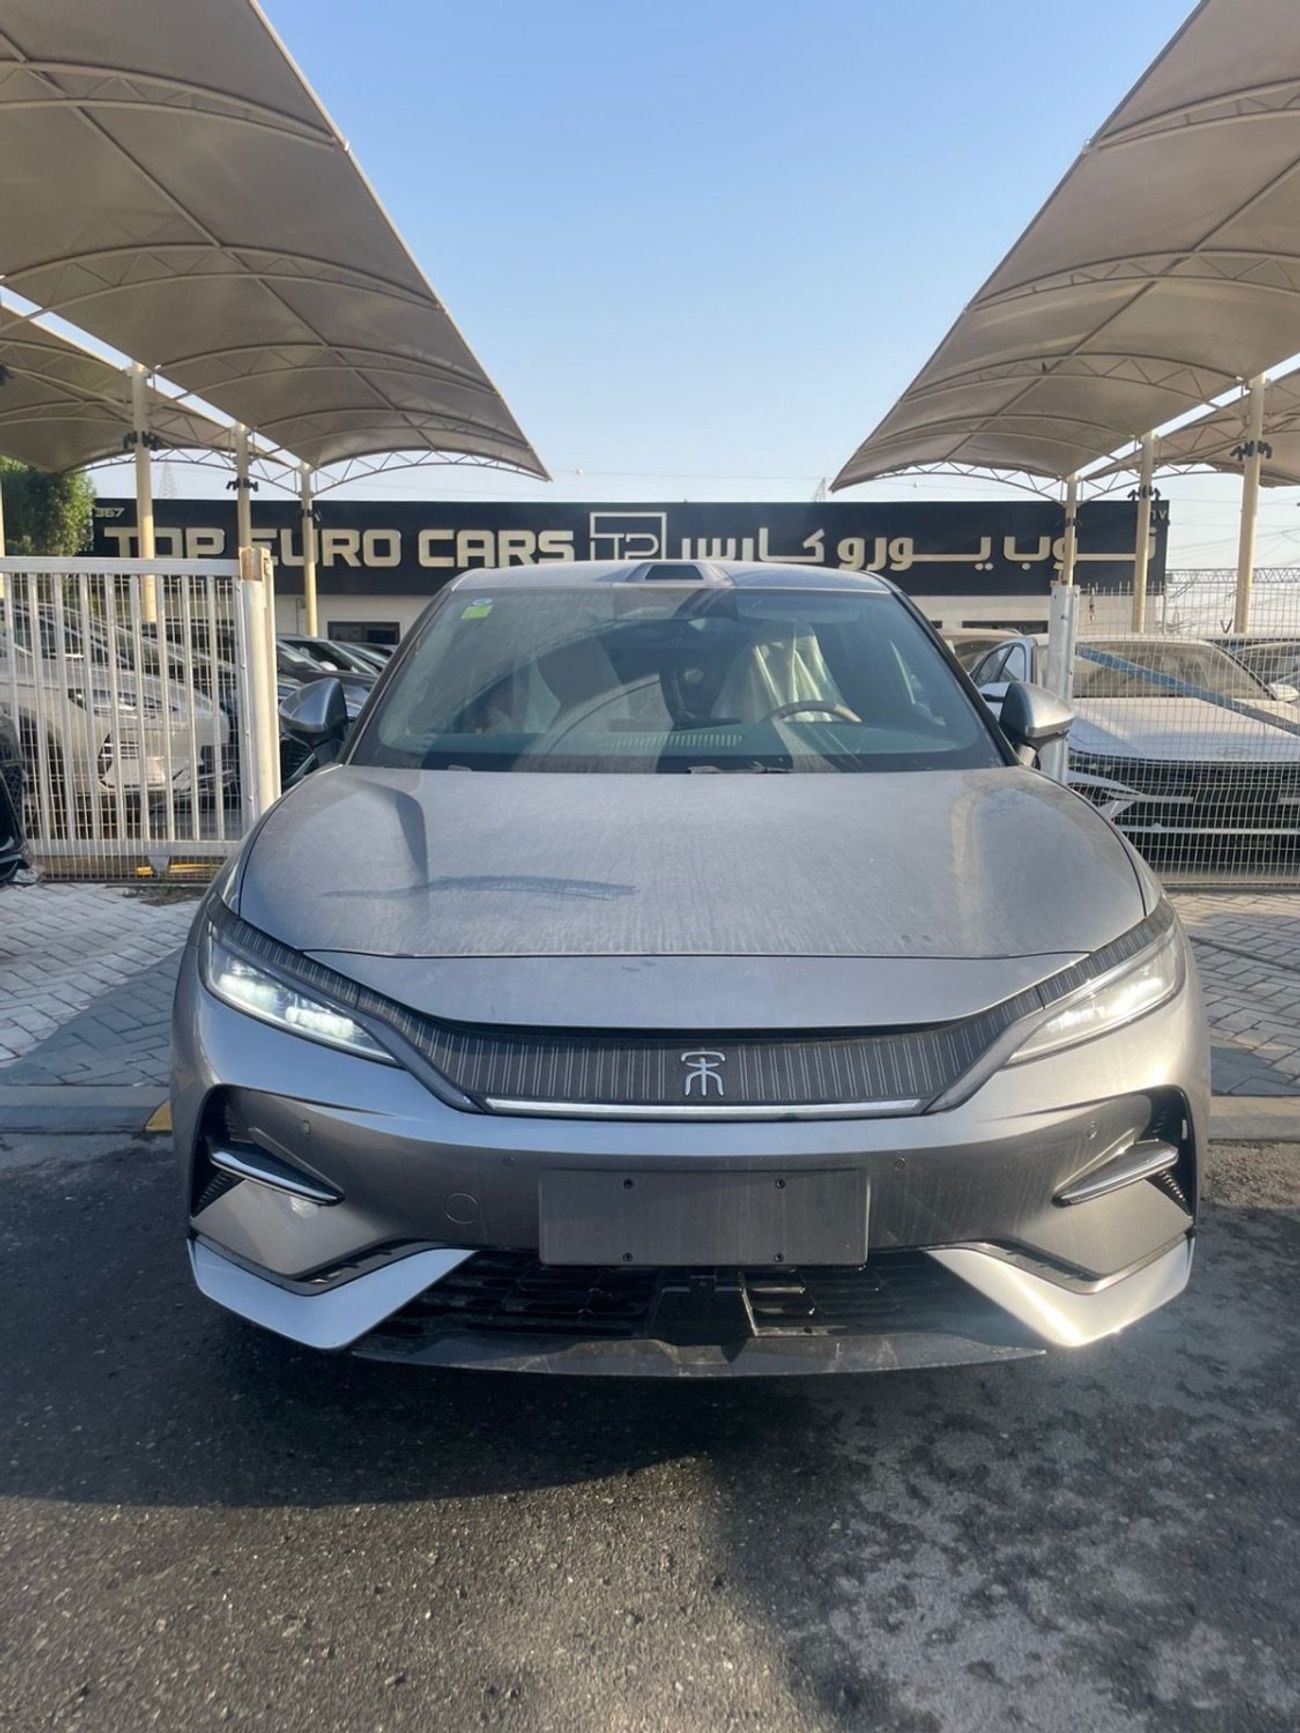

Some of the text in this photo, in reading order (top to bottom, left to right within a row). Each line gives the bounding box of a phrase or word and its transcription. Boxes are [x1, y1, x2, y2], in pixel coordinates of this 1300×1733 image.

[104, 527, 226, 559] TOP
[418, 529, 575, 567] CARS
[682, 527, 825, 562] كارس
[836, 536, 992, 571] يورو
